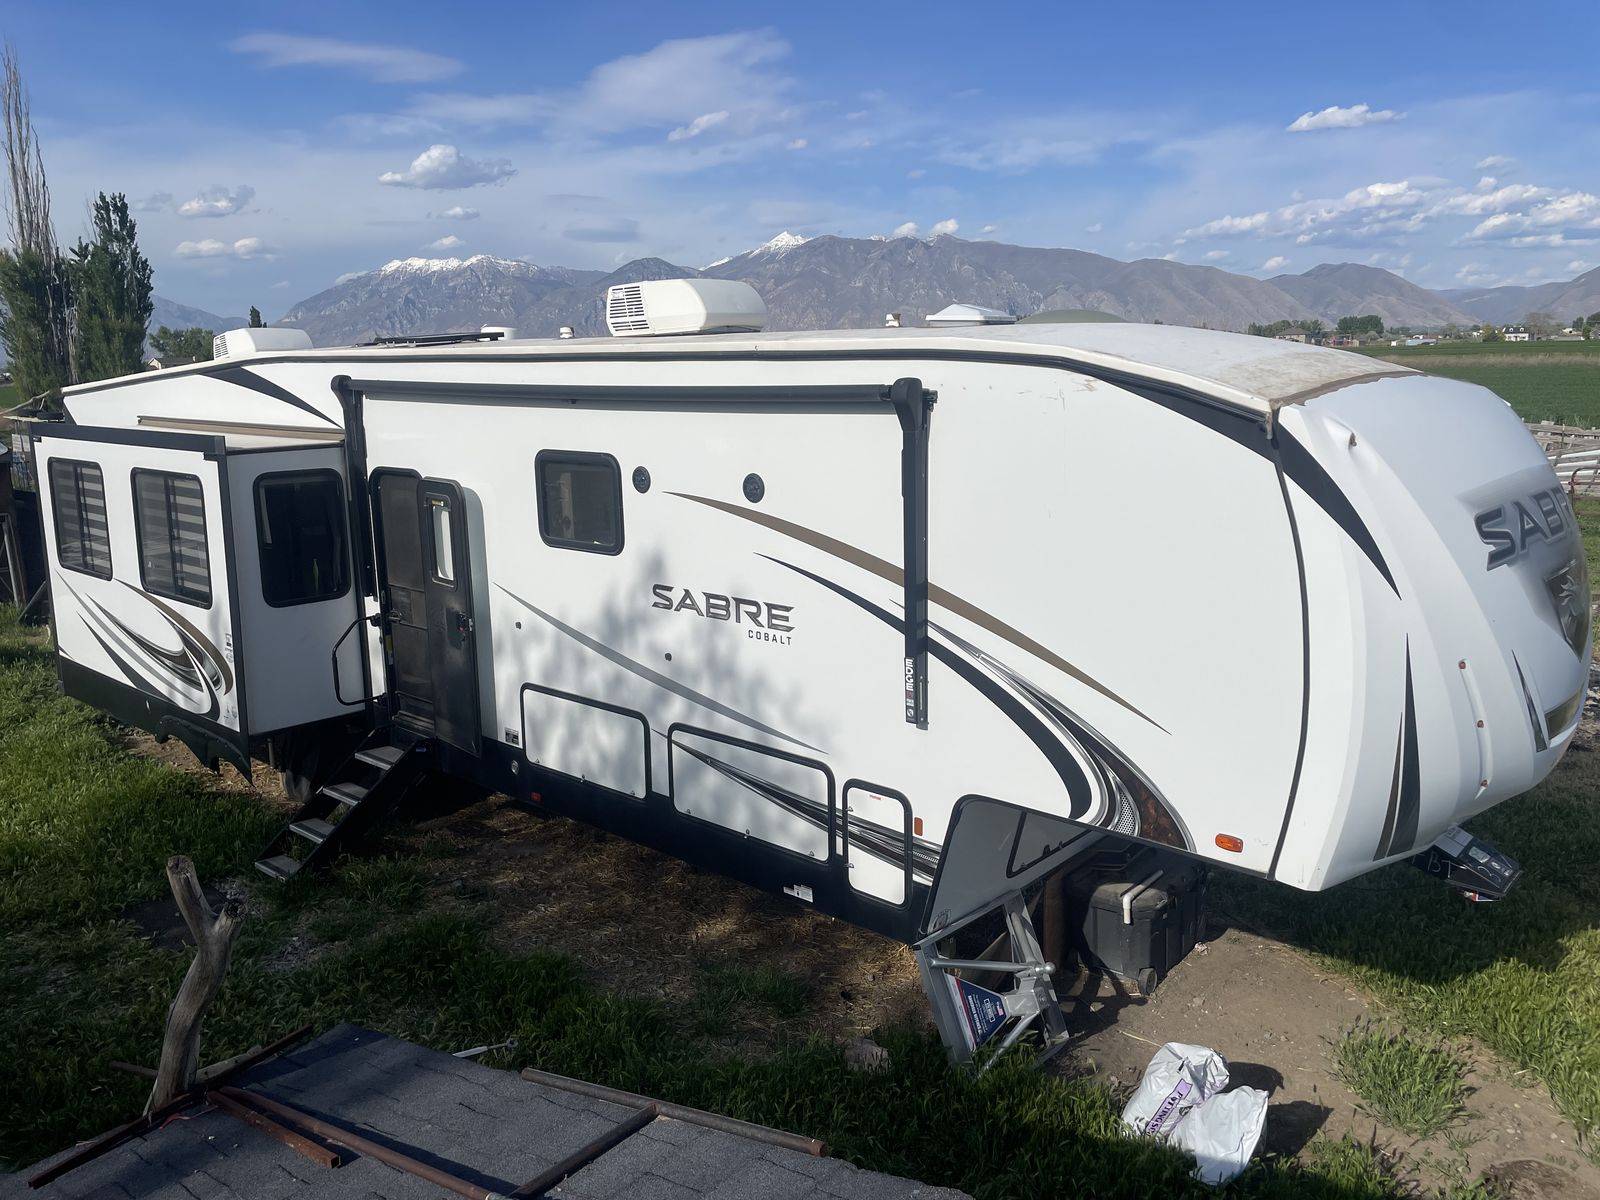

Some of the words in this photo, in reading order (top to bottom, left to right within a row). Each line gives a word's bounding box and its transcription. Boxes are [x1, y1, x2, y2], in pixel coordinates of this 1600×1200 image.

[1474, 487, 1571, 571] SABR
[652, 584, 795, 632] SABRE
[748, 629, 792, 645] COBALT
[905, 657, 914, 691] EDGE
